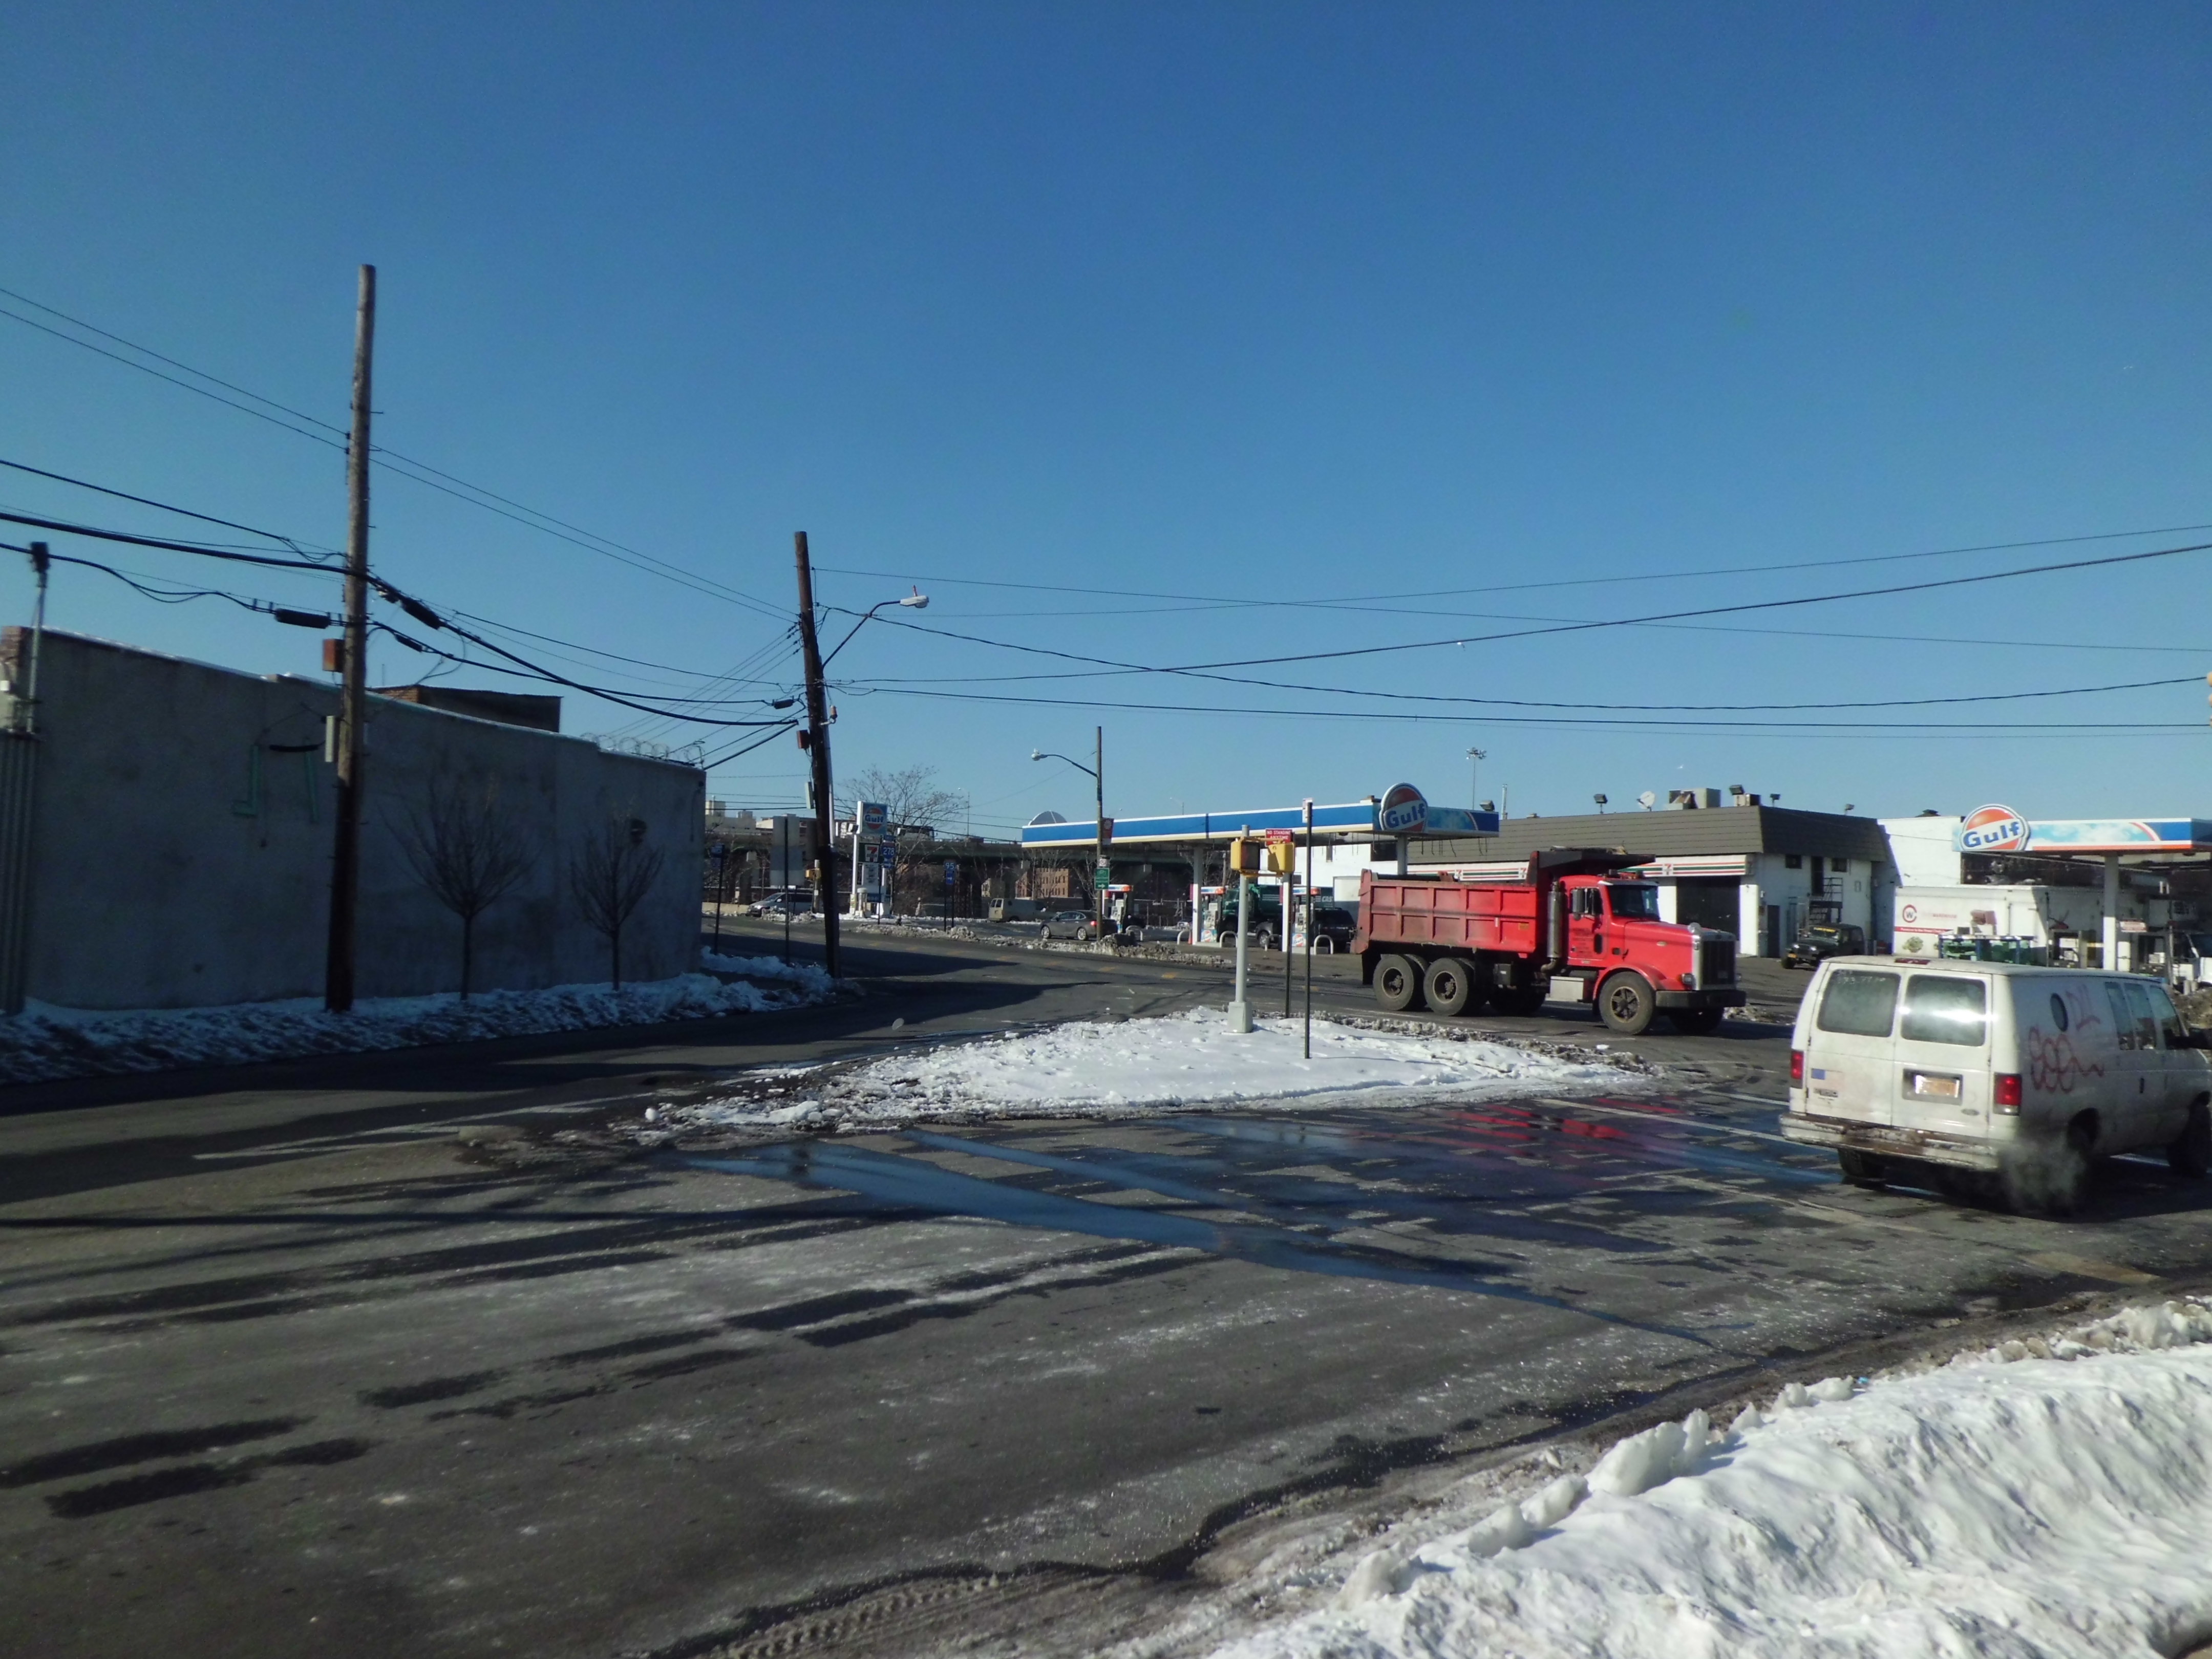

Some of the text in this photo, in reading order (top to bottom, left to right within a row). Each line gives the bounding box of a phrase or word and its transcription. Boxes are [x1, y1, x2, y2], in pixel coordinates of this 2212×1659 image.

[864, 814, 884, 822] Gulf
[1386, 803, 1426, 828] Gulf
[1963, 821, 2019, 847] Gulf
[883, 847, 895, 855] 278
